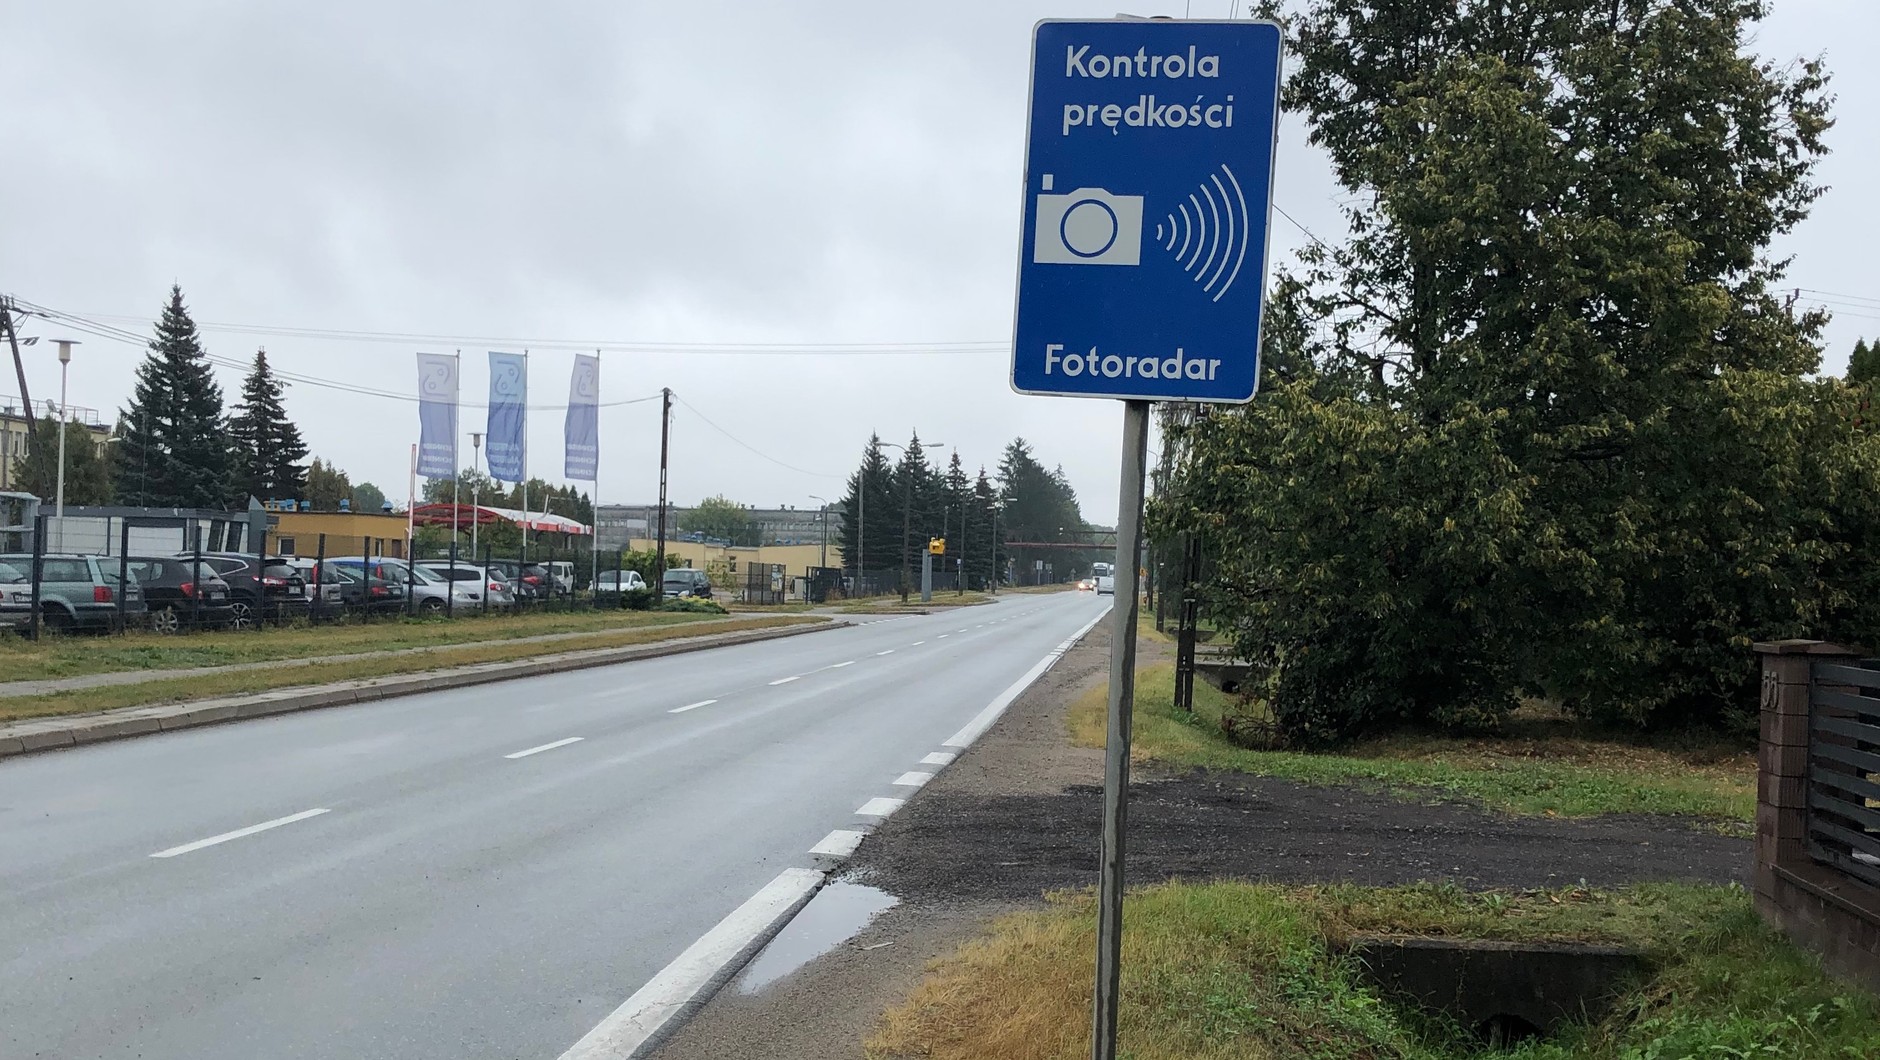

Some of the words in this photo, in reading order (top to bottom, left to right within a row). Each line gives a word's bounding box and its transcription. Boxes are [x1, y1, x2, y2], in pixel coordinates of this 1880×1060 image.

[1065, 45, 1219, 78] Kontrola
[1062, 95, 1234, 135] prędkości
[1045, 344, 1220, 381] Fotoradar
